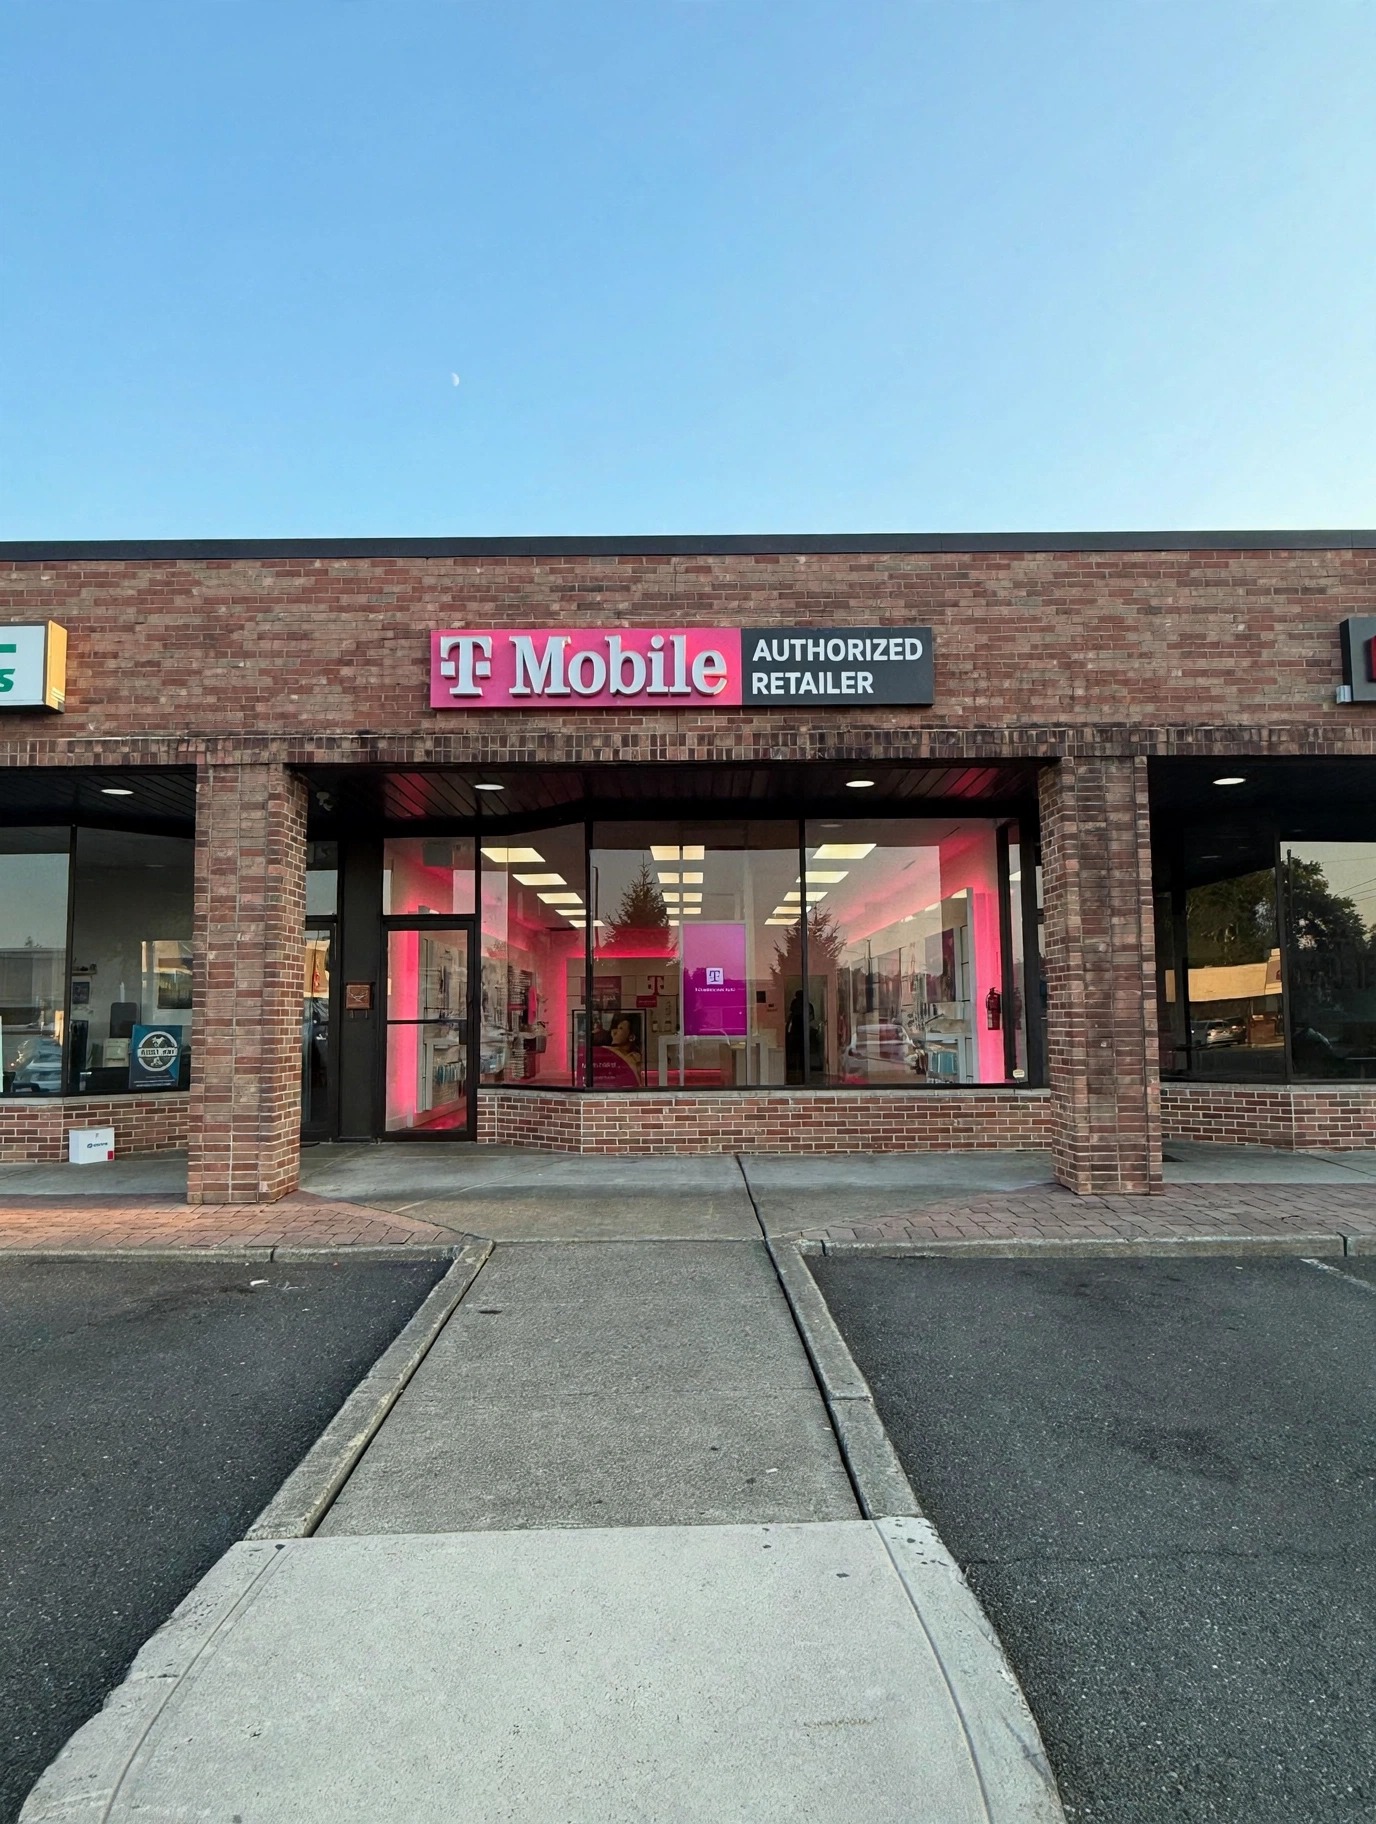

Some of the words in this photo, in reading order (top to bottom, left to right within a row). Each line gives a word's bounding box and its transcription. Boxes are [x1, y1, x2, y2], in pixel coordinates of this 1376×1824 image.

[752, 638, 923, 662] AUTHORIZED
[440, 635, 492, 697] T
[508, 634, 728, 696] Mobile
[752, 671, 874, 695] RETAILER
